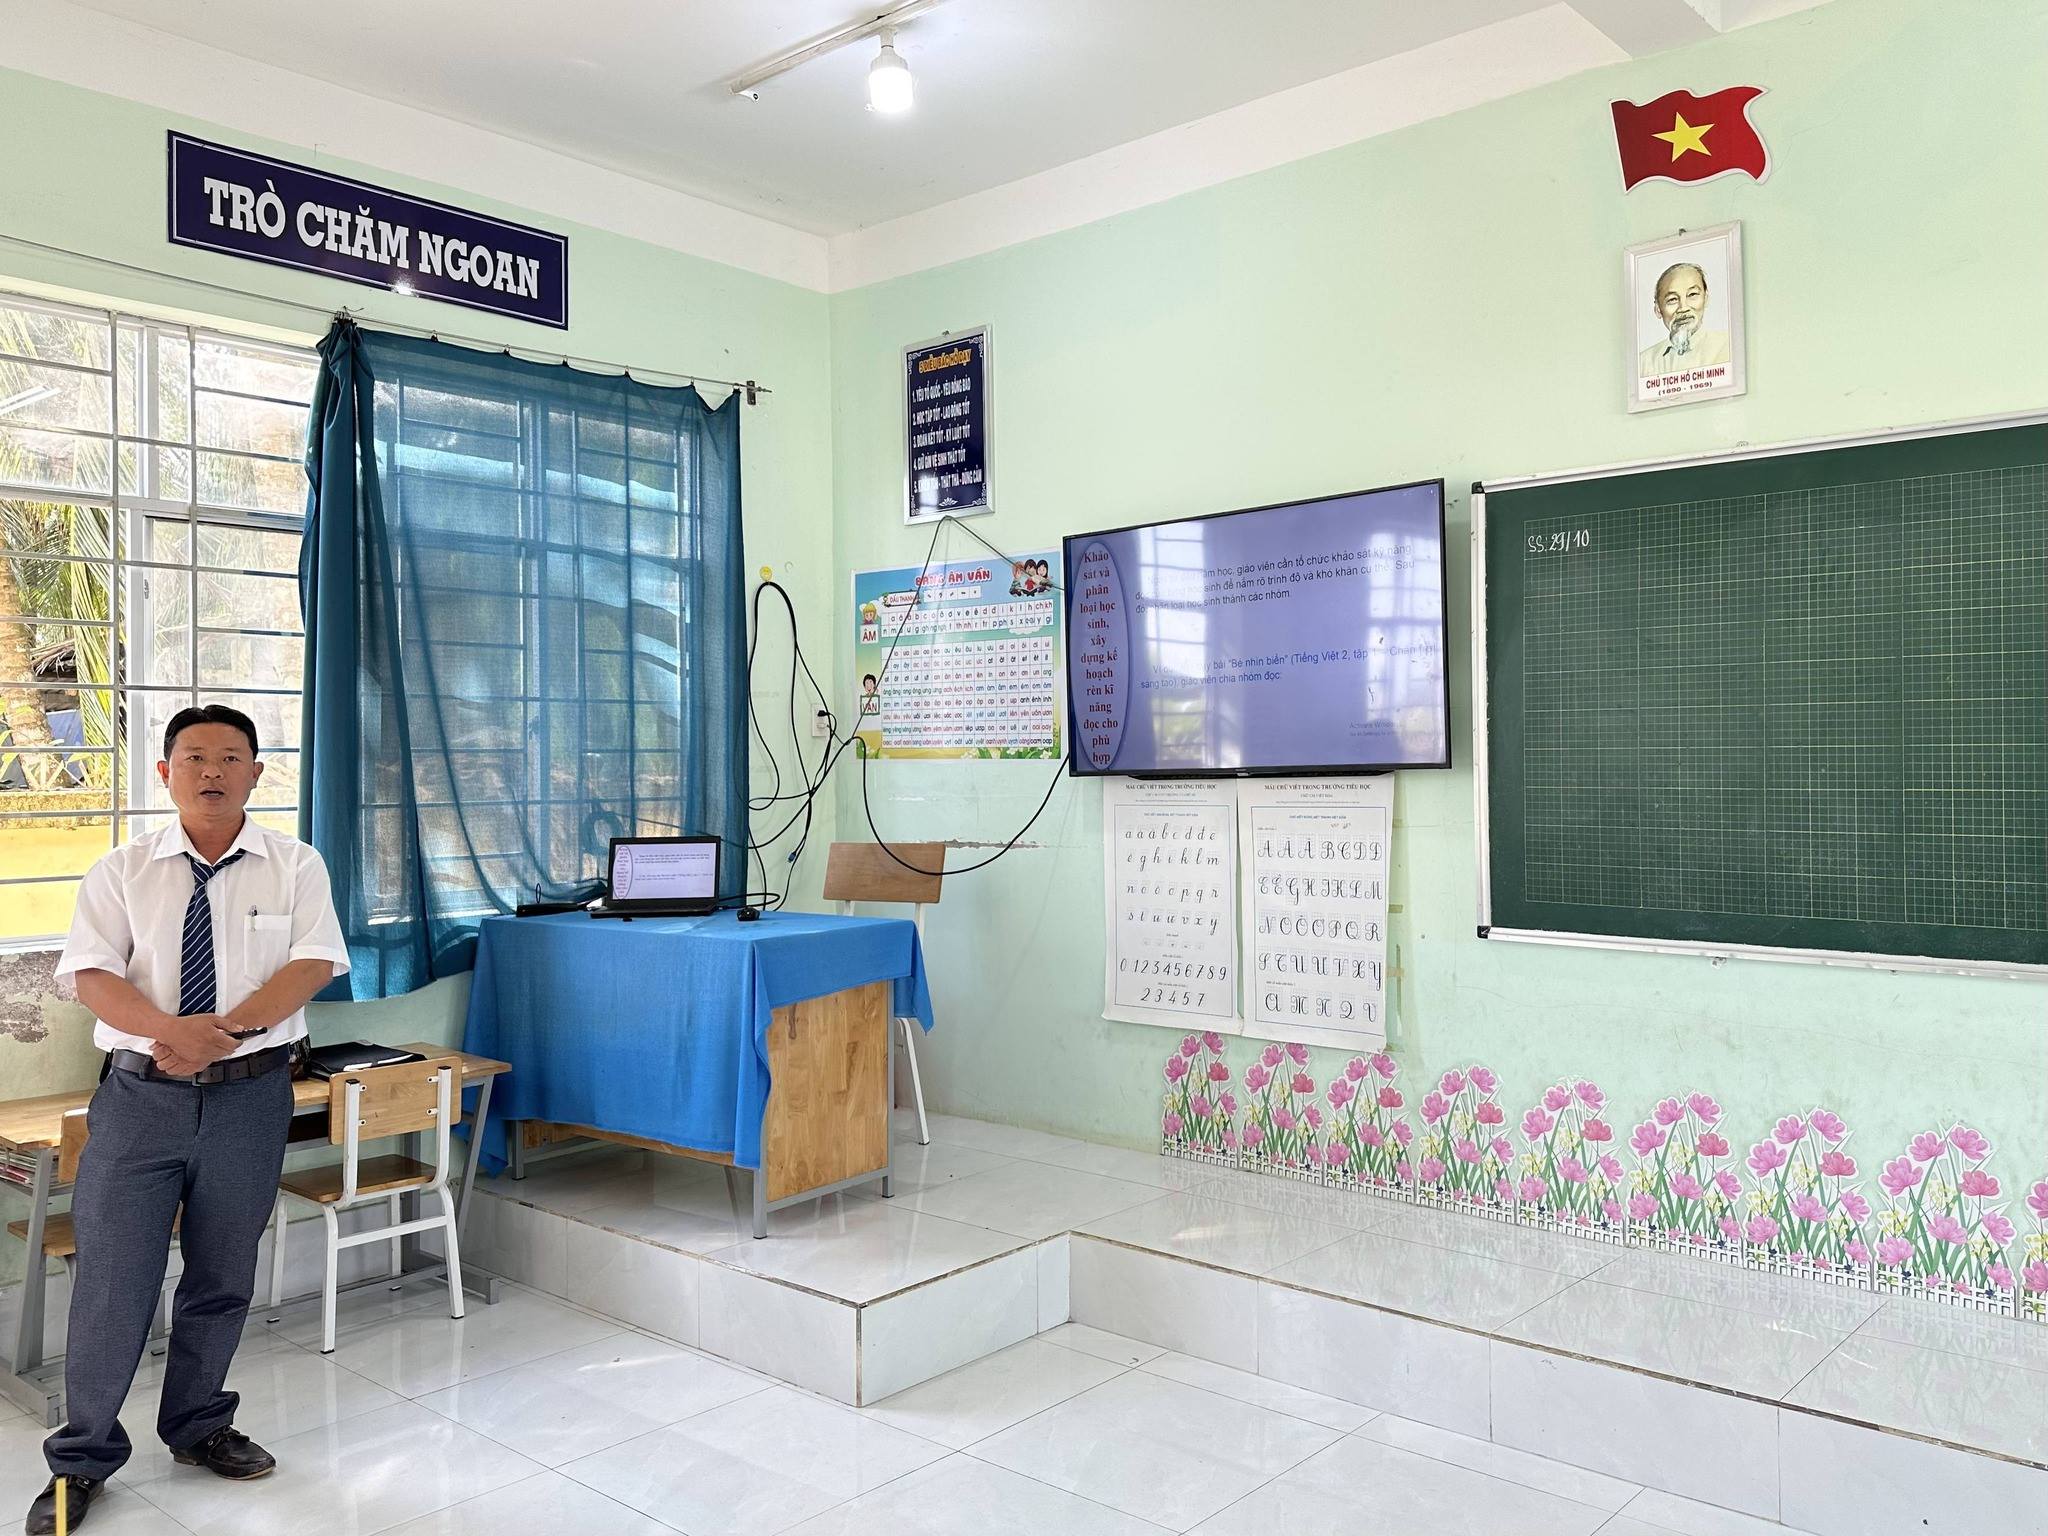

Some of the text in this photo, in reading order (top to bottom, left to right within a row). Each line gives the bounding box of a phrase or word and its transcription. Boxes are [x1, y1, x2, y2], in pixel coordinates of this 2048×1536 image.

[204, 177, 540, 300] TRÒ CHĂM NGOAN
[1646, 375, 1660, 389] CHỦ
[1692, 368, 1704, 380] CHÍ
[1706, 367, 1725, 378] MINH
[1690, 381, 1713, 390] 1969)
[1084, 551, 1109, 563] Khảo
[1237, 563, 1255, 576] giáo
[1257, 560, 1275, 571] viên
[1278, 557, 1293, 569] cần
[1307, 553, 1330, 565] chức
[1332, 549, 1354, 562] khảo
[1357, 548, 1371, 559] sát
[1083, 567, 1110, 580] sát và
[1290, 571, 1301, 583] độ
[1086, 584, 1109, 599] phân
[1204, 596, 1221, 606] sinh
[1223, 593, 1246, 604] thành
[1248, 592, 1263, 602] các
[1080, 601, 1116, 615] loại học
[863, 629, 876, 641] ÂM
[1091, 635, 1107, 648] xây
[1081, 648, 1118, 665] dựng kế
[1245, 656, 1264, 667] nhìn
[1291, 652, 1318, 666] (Tiếng
[1322, 651, 1339, 662] Việt
[1086, 668, 1113, 681] hoạch
[1219, 673, 1236, 683] chia
[1238, 672, 1261, 682] nhóm
[1089, 702, 1112, 714] năng
[1083, 718, 1118, 732] đọc cho
[1092, 735, 1110, 748] phù
[1092, 753, 1111, 765] hợp
[1321, 841, 1335, 859] B
[1337, 842, 1351, 860] C
[1280, 917, 1292, 935] O
[1346, 921, 1360, 940] Q
[1365, 923, 1383, 941] R
[1120, 958, 1226, 980] 0 1 2 3 4 5 6 7 8 9
[1352, 960, 1381, 991] X Y
[1140, 988, 1205, 1006] 2 3 4 5 7
